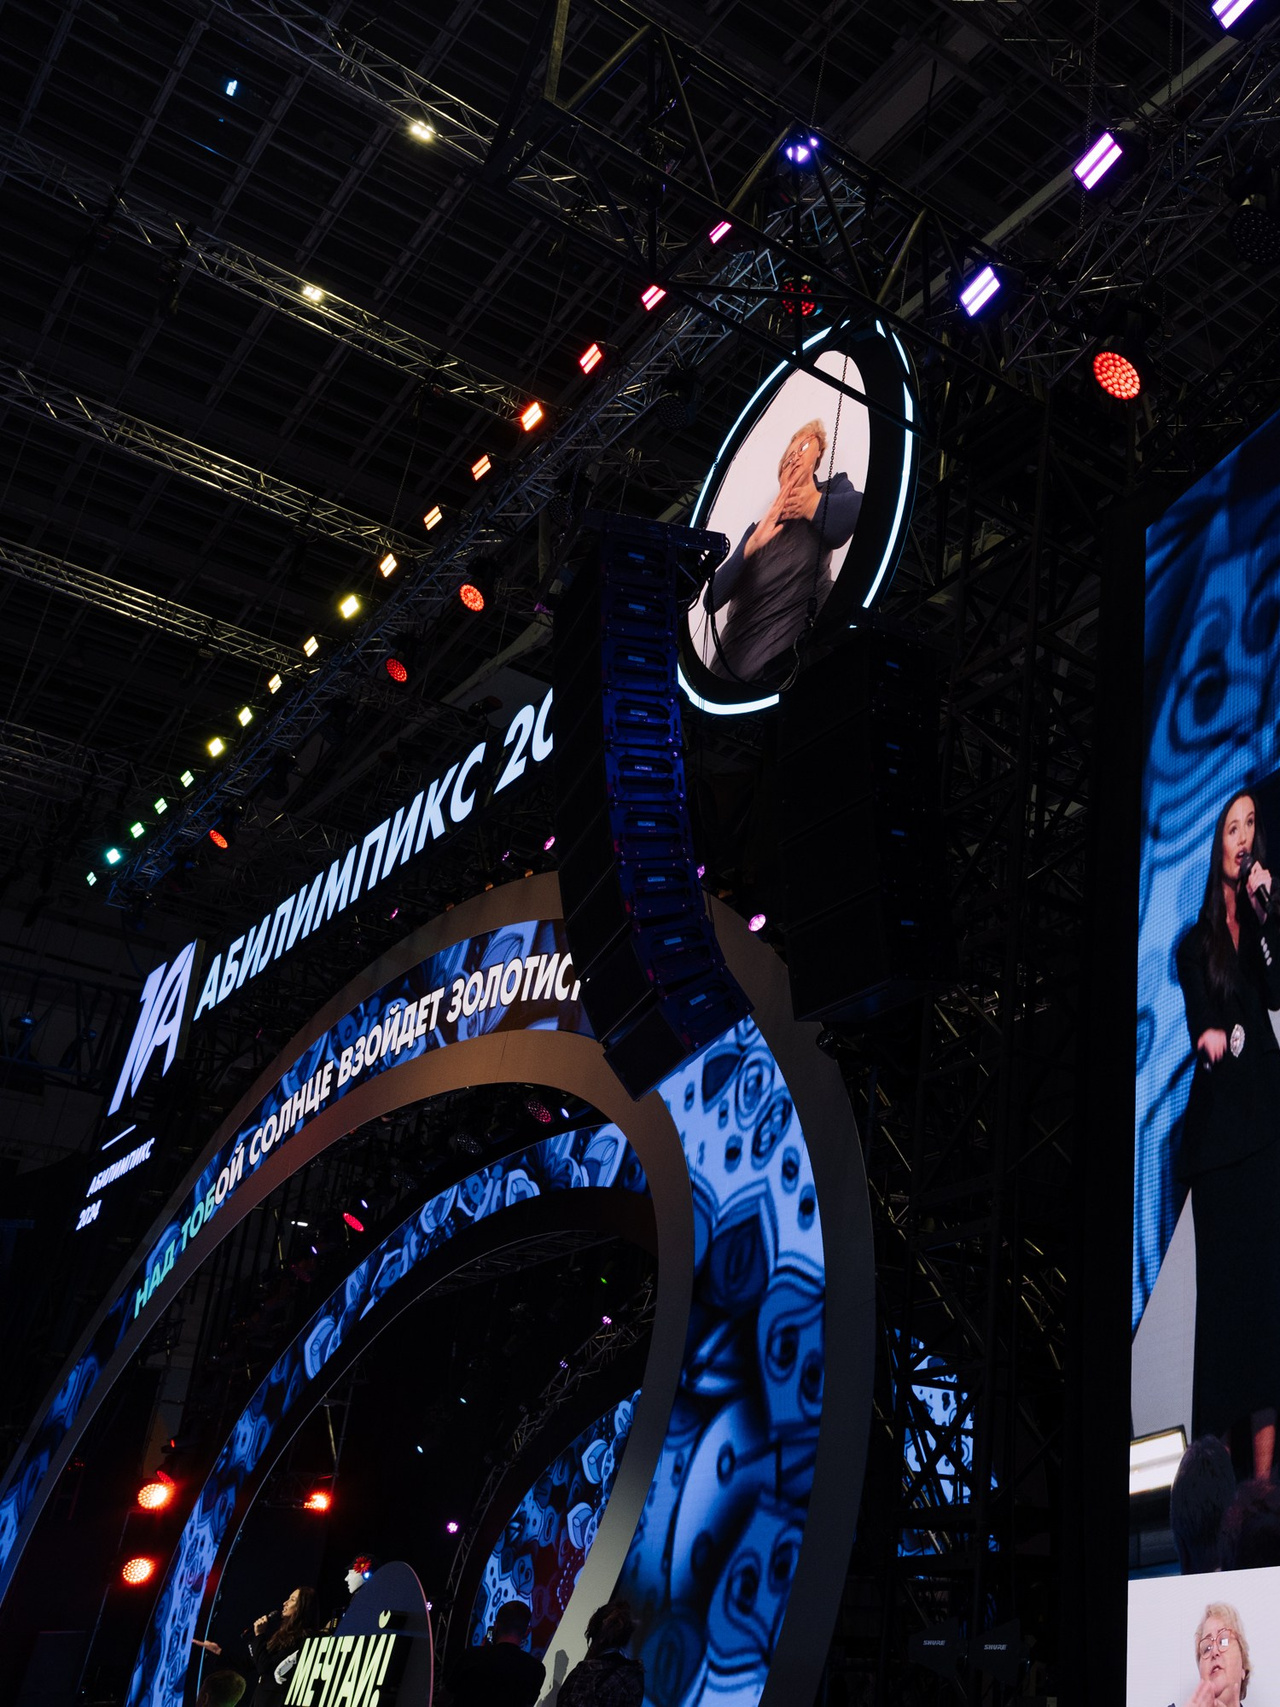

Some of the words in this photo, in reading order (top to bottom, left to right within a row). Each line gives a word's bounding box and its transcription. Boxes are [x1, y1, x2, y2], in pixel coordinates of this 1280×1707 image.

[194, 742, 487, 1021] АБИЛИМПИКС
[86, 1137, 156, 1198] АБИЛИМПИКС
[134, 1242, 176, 1320] НАД
[181, 1147, 245, 1252] ТОБОЙ
[249, 1060, 335, 1163] СОЛНЦЕ
[336, 986, 446, 1089] ВЗОЙДЕТ
[284, 1610, 397, 1707] МЕЧТАЙ!
[983, 1643, 1007, 1651] SHURE
